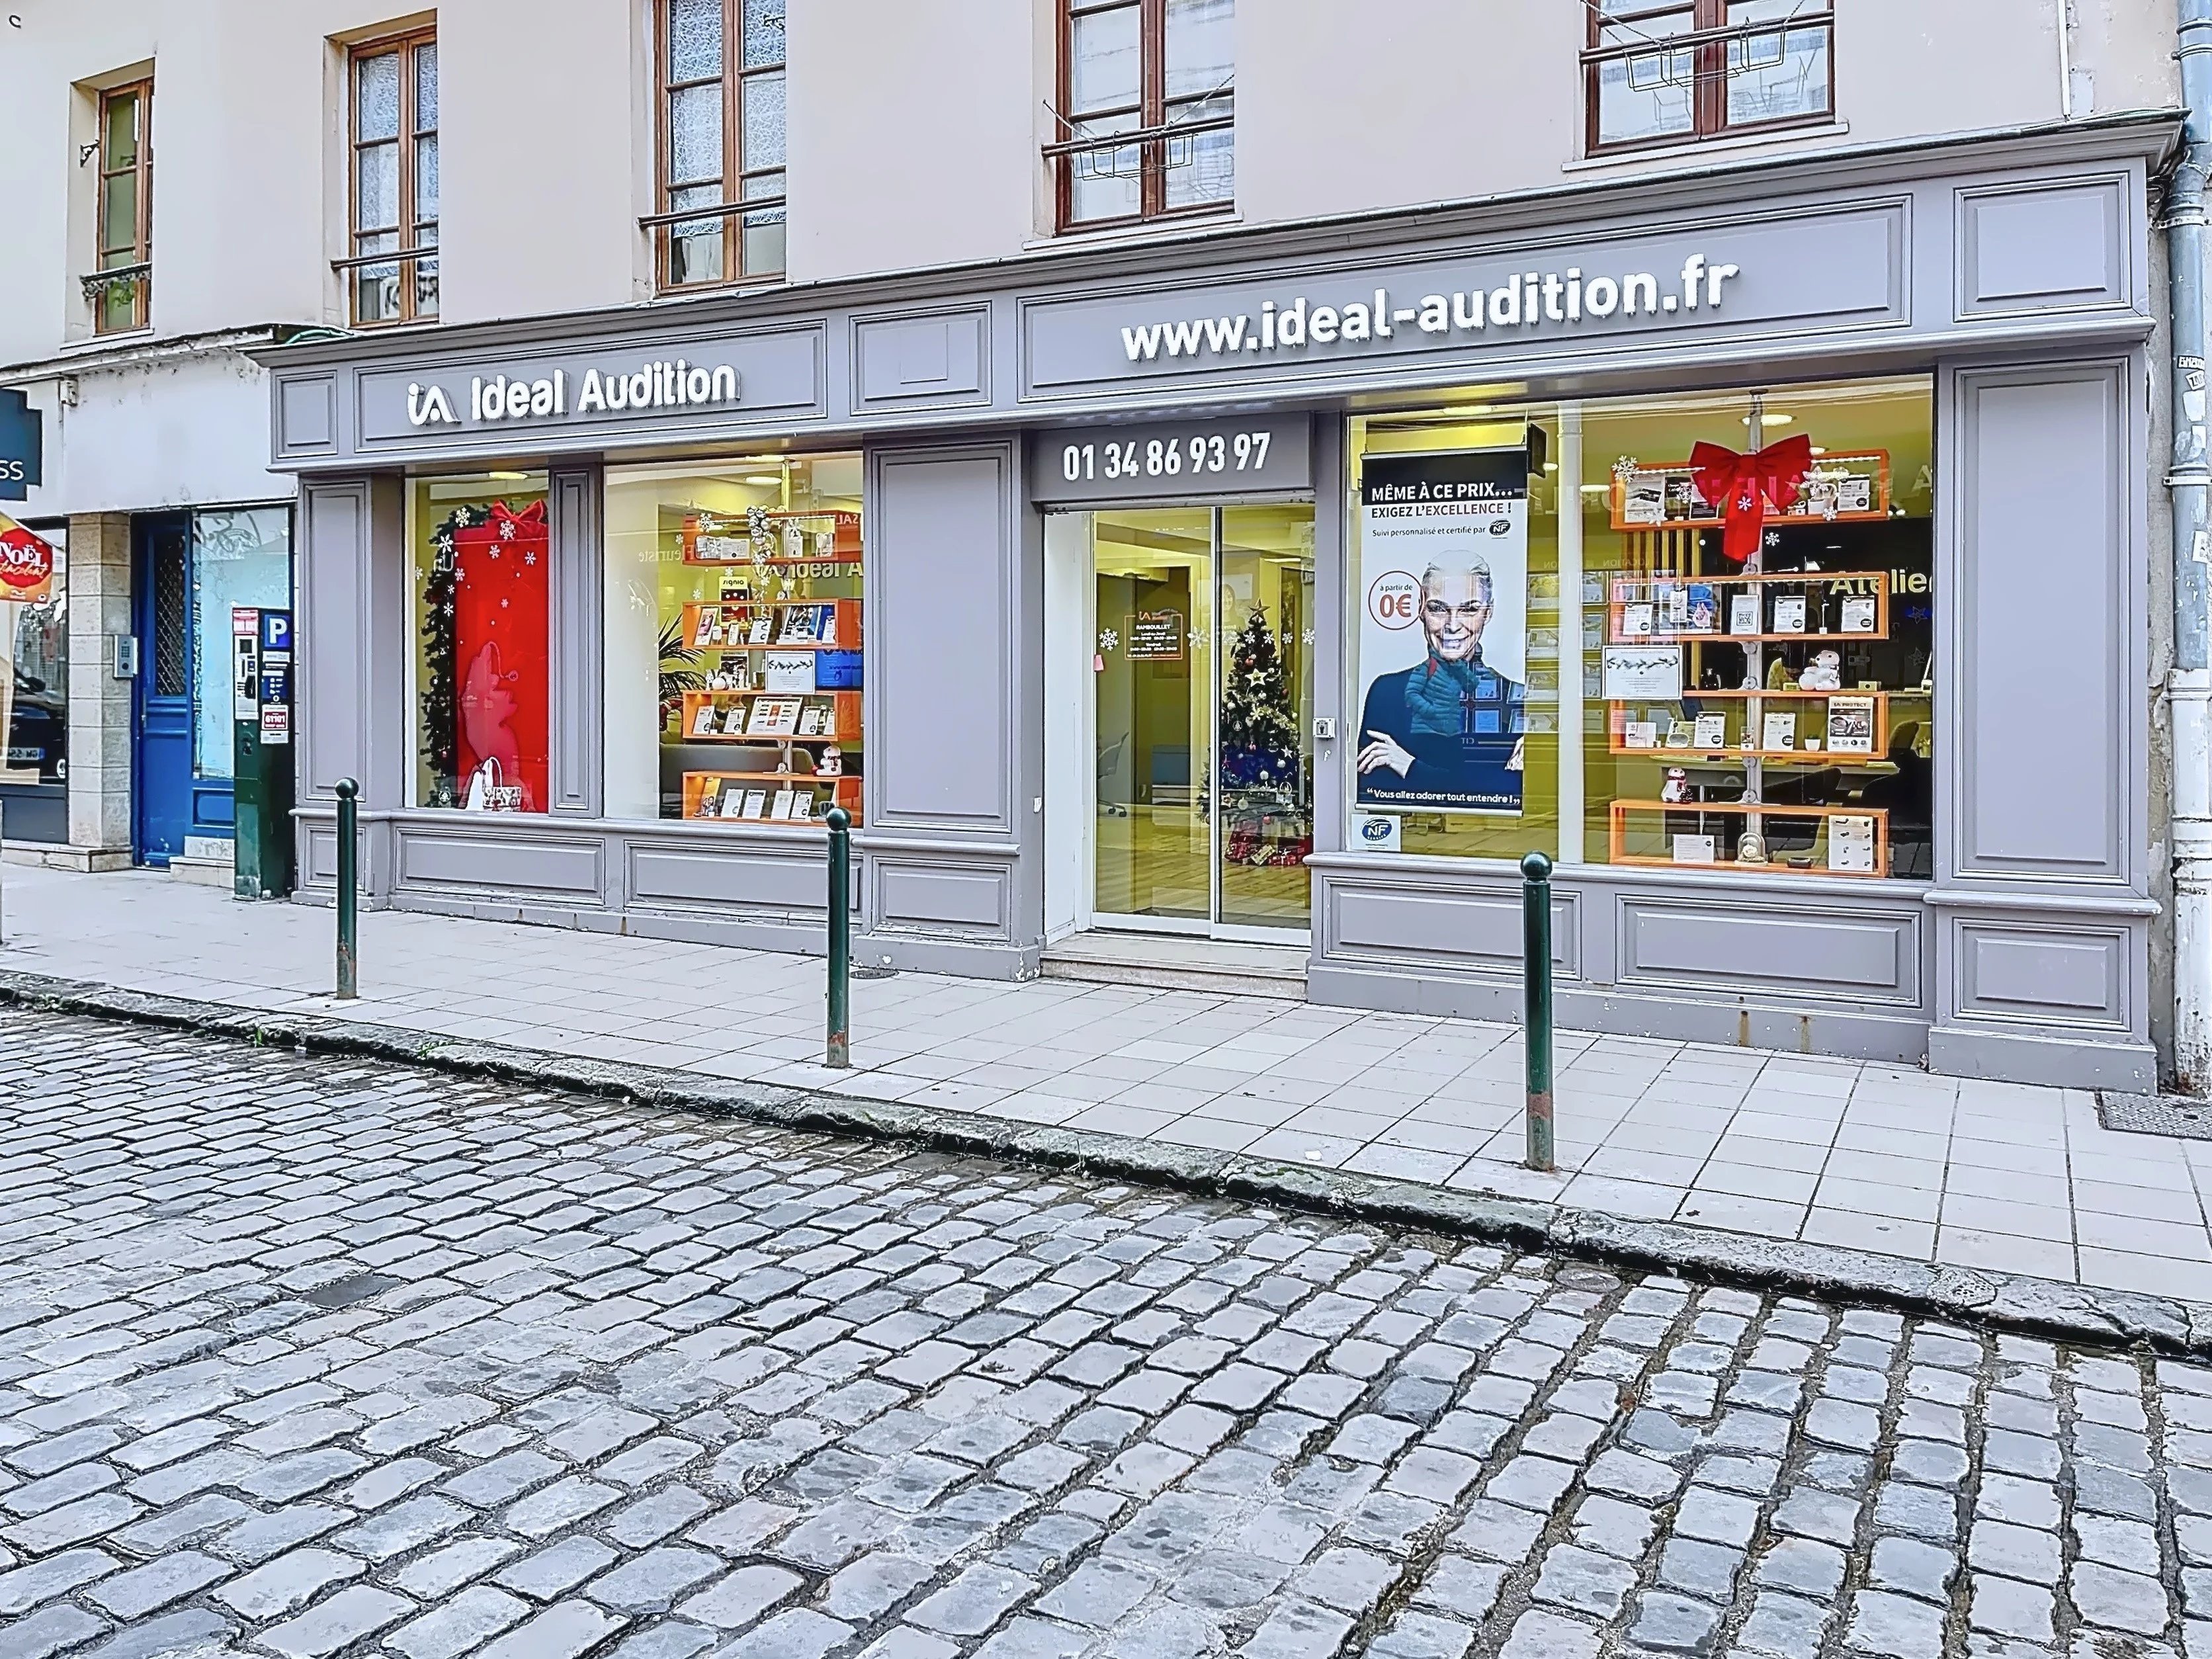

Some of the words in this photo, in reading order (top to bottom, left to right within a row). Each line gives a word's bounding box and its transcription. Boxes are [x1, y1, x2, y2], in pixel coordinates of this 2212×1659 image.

[1121, 253, 1739, 362] www.ideal-audition.fr
[472, 368, 567, 421] Ideal
[577, 358, 741, 413] Audition
[1064, 444, 1093, 481] 01
[1105, 441, 1139, 478] 34
[1146, 439, 1181, 476] 86
[1189, 435, 1225, 473] 93
[1234, 432, 1270, 470] 97
[1371, 484, 1416, 501] MÊME
[1419, 482, 1430, 499] À
[1433, 484, 1453, 499] CE
[1457, 482, 1512, 498] PRIX...
[1371, 506, 1413, 519] EXIGEZ
[1390, 525, 1436, 538] personnalisé
[1446, 525, 1472, 534] certifié
[1473, 527, 1486, 535] par
[1493, 524, 1508, 532] NF
[1379, 593, 1412, 618] 0€
[270, 618, 287, 644] P
[1396, 790, 1416, 800] allez
[1416, 791, 1446, 801] adorer
[1447, 793, 1466, 802] tout
[1467, 793, 1508, 803] entendre
[1368, 825, 1388, 835] NF
